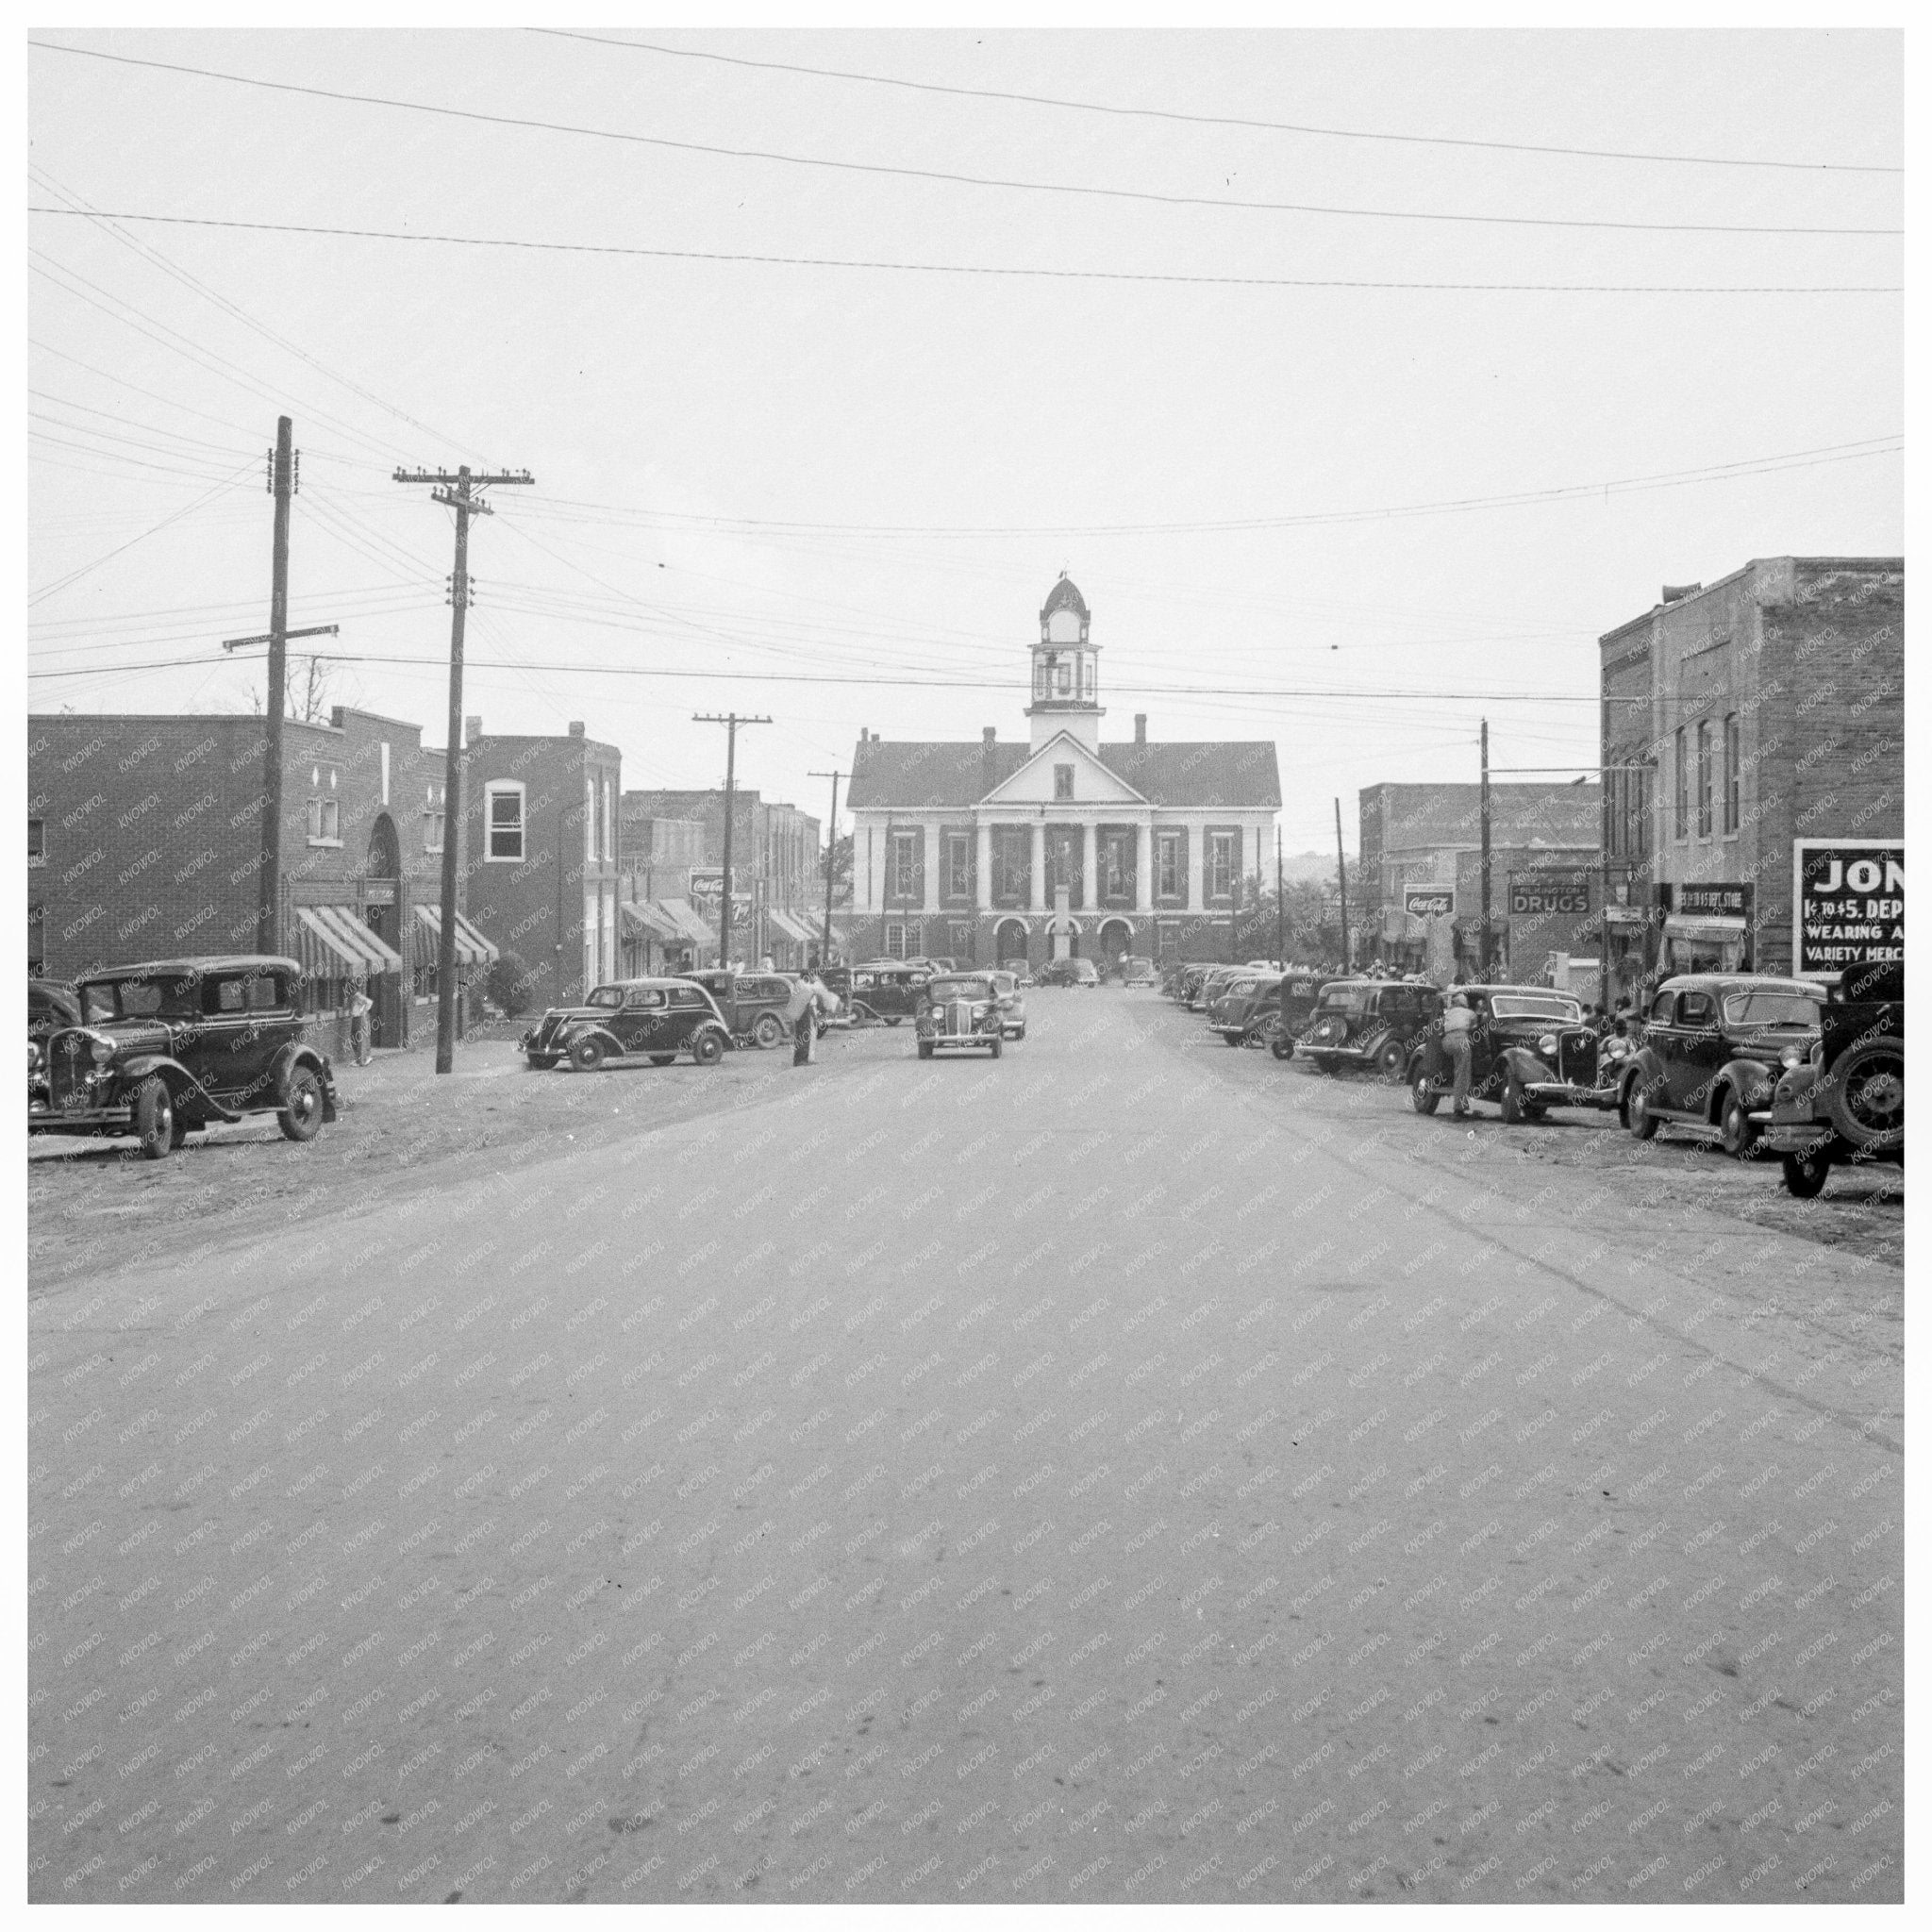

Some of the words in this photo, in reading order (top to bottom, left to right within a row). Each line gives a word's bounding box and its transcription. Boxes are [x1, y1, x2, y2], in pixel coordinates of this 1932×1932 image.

[1513, 895, 1588, 912] DRUGS
[1821, 902, 1835, 915] TO
[1866, 899, 1903, 919] DEP
[1806, 925, 1883, 940] WEARING
[1806, 946, 1862, 961] VARIETY
